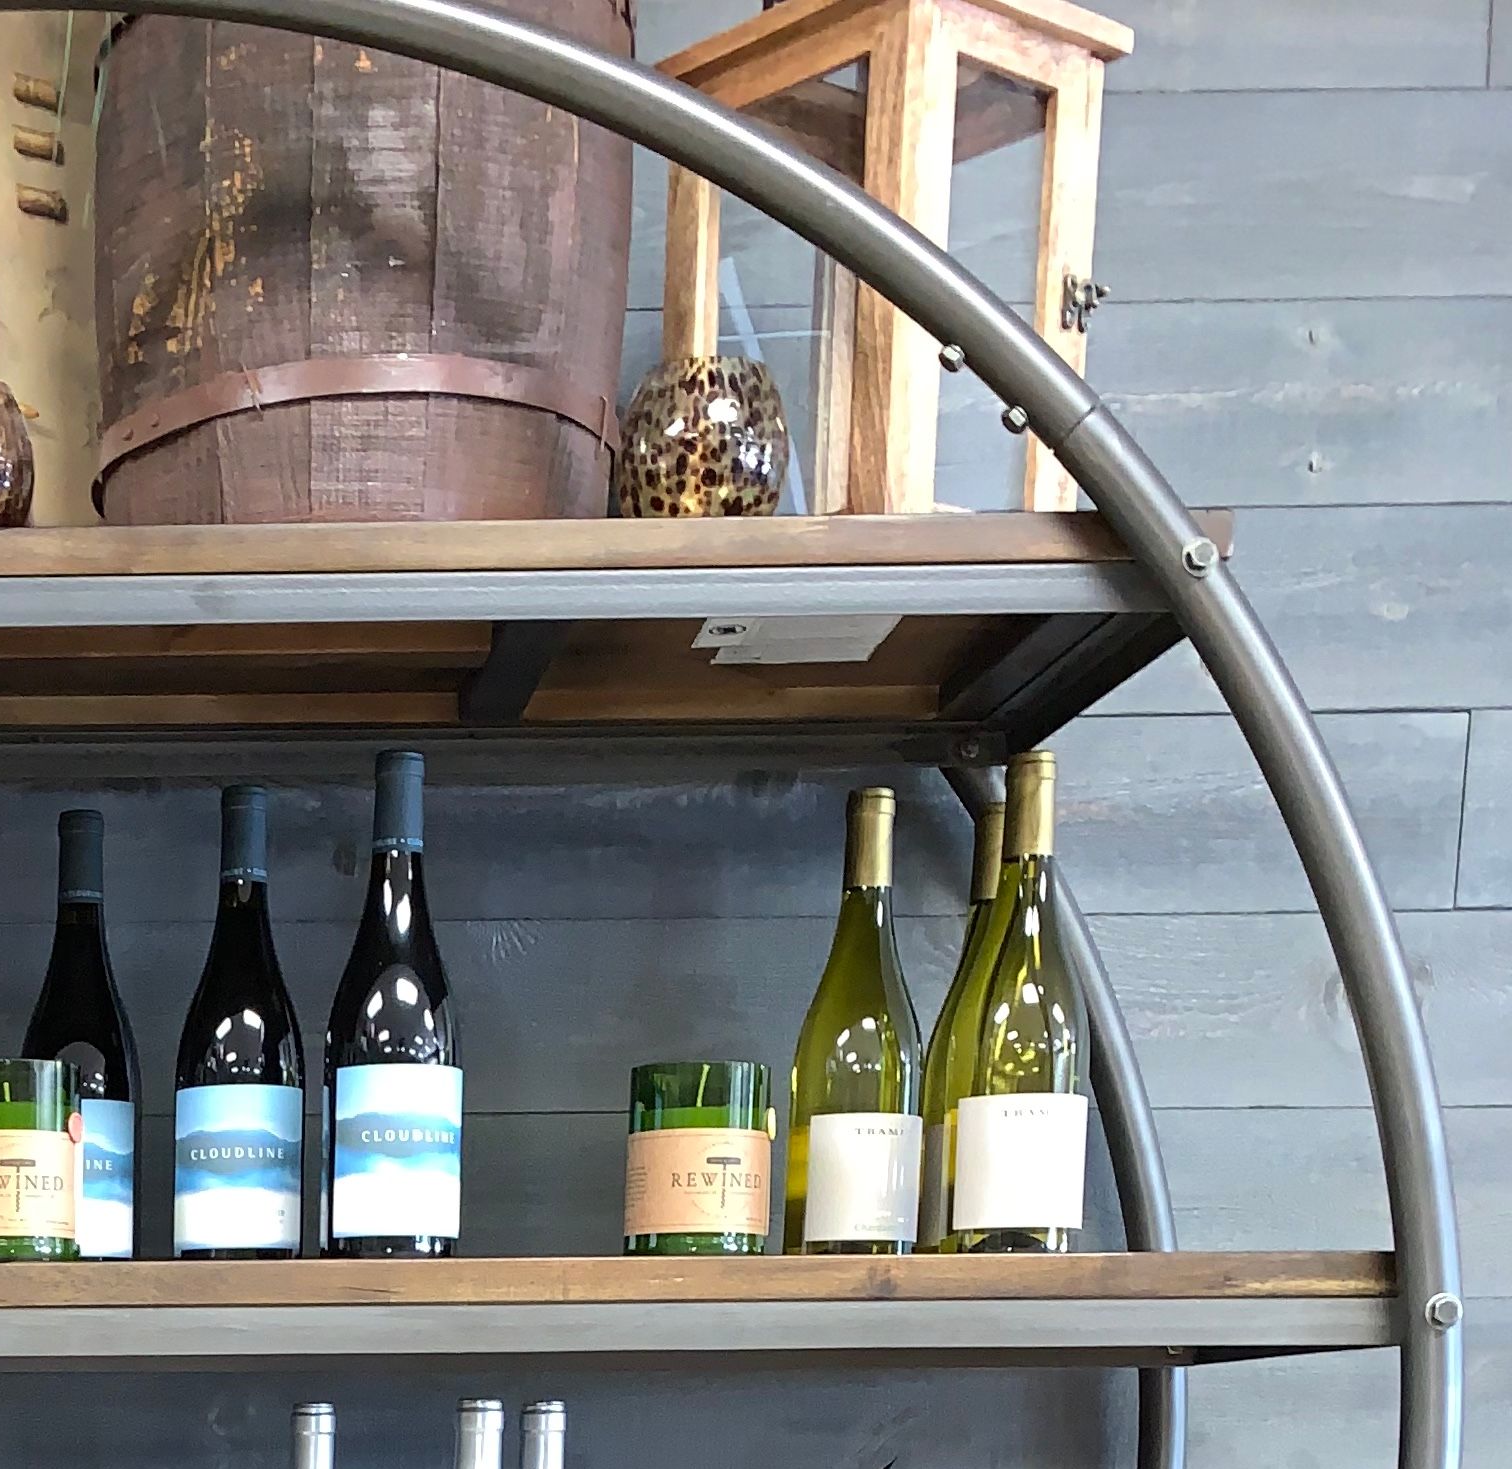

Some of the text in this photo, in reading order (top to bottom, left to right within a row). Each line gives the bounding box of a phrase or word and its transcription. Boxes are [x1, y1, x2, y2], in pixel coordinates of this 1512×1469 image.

[361, 1128, 455, 1145] CLOUDLINE
[190, 1146, 286, 1161] CLOUDLINE
[671, 1171, 762, 1189] REWINED
